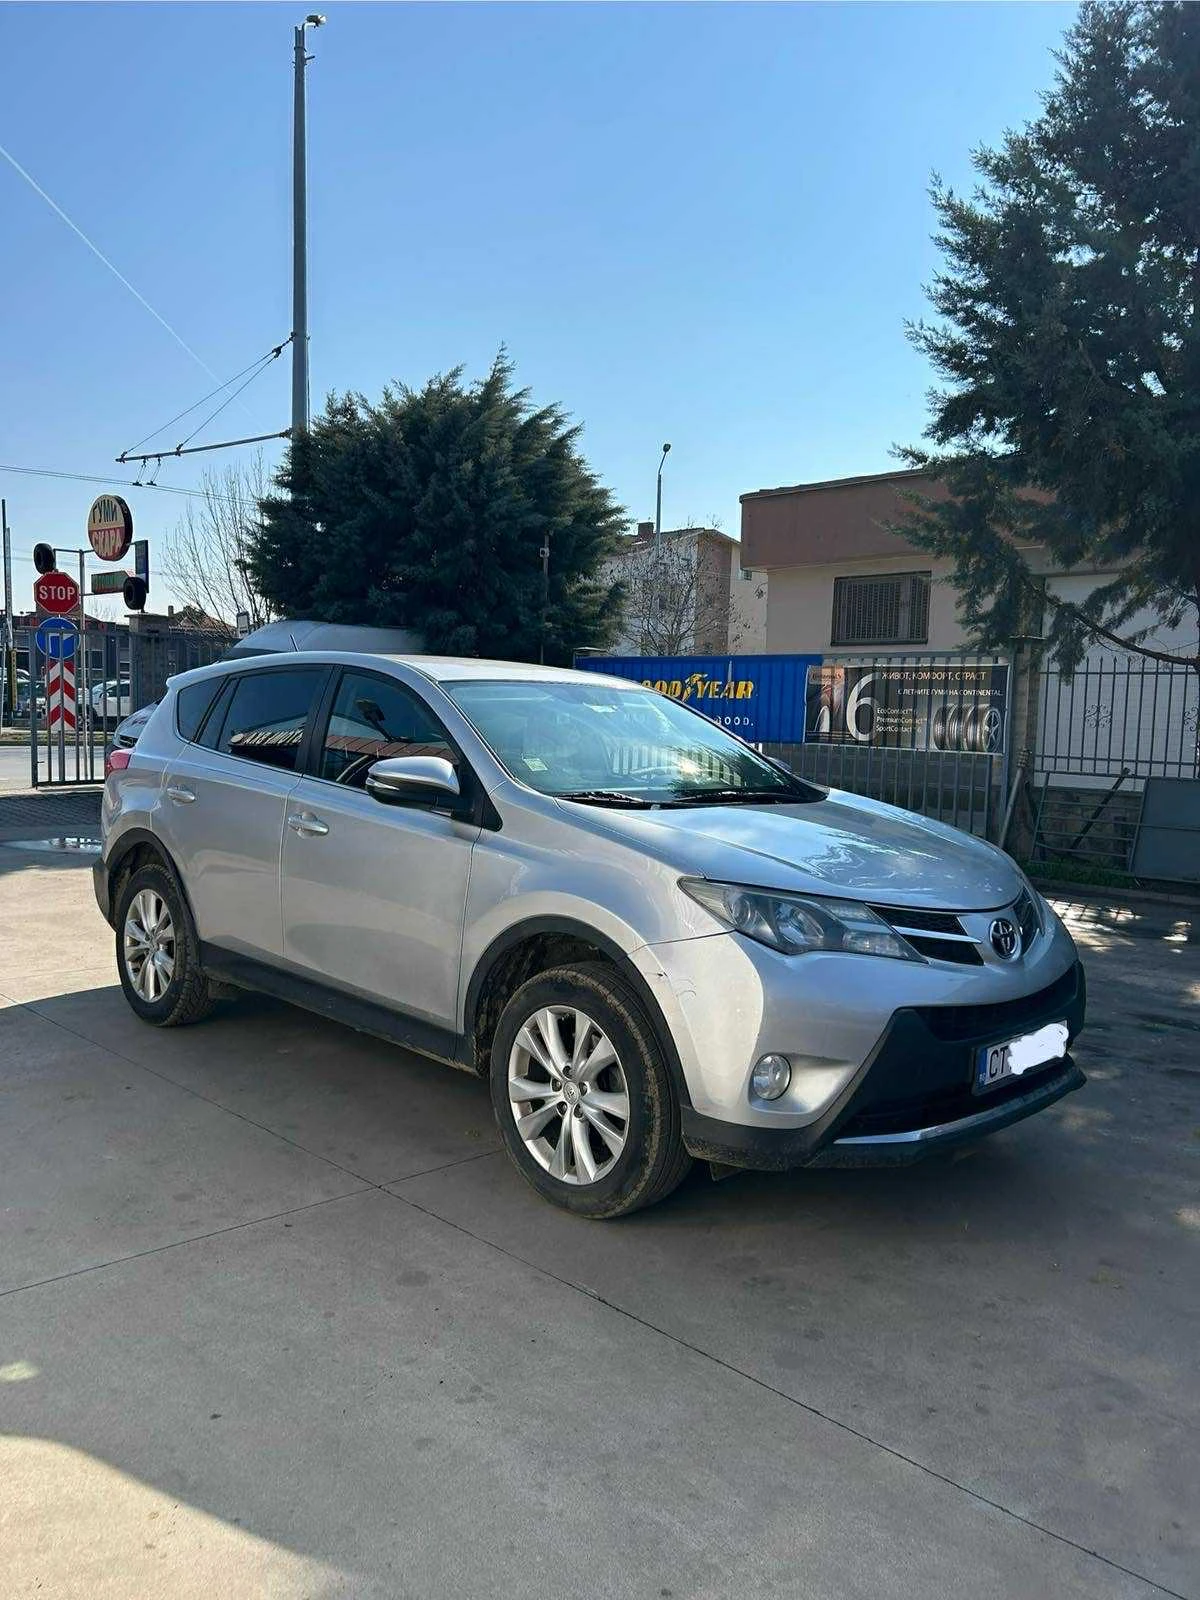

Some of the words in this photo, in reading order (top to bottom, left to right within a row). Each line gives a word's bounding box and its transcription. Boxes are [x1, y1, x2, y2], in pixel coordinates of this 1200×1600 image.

[39, 585, 76, 601] STOP
[641, 680, 754, 699] ODYEAR
[846, 672, 879, 741] 6
